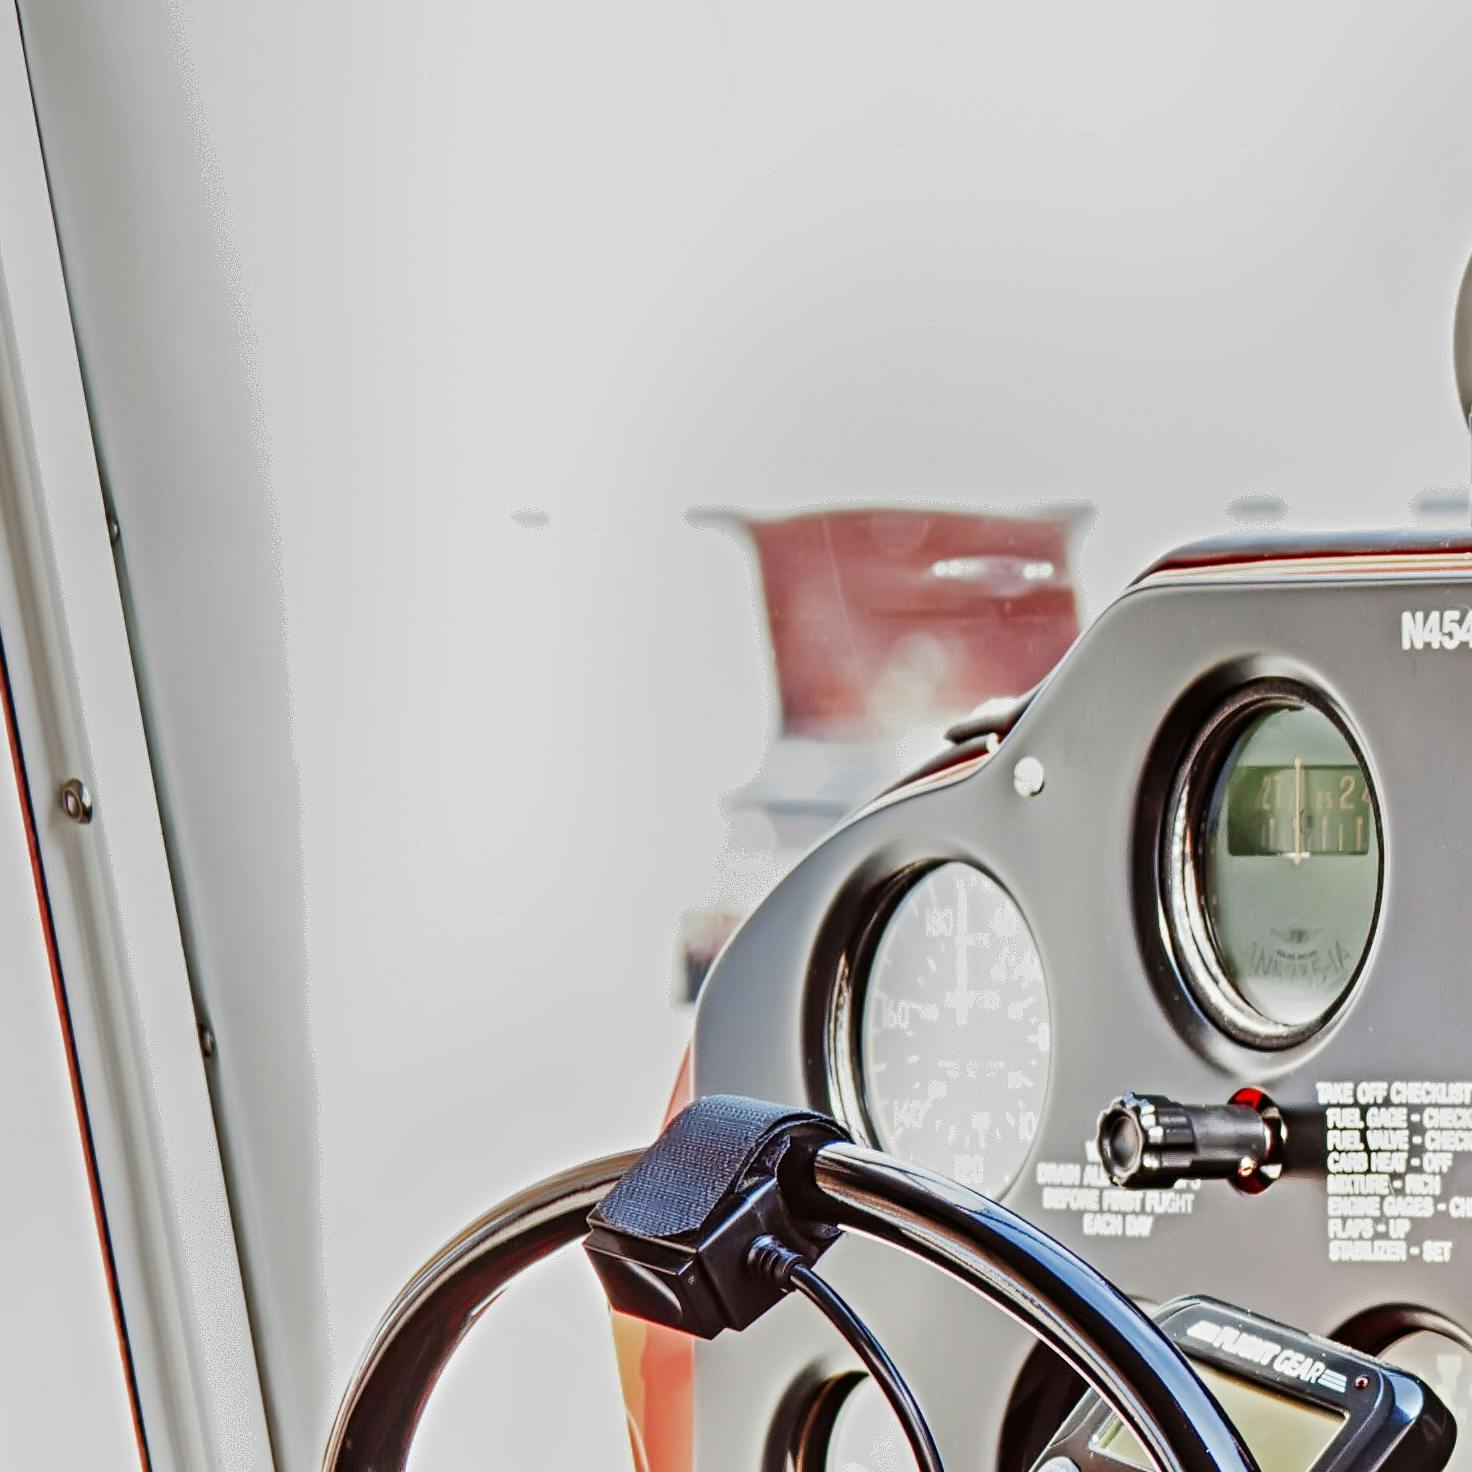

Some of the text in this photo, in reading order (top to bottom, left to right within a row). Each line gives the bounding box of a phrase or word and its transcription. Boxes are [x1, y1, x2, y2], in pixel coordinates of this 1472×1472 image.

[1356, 1081, 1389, 1105] OFF
[1326, 1107, 1365, 1128] FUEL
[1326, 1130, 1365, 1151] FUEL
[1327, 1151, 1453, 1174] CARB HEAT OFF
[1145, 1190, 1195, 1215] FLIGHT
[1083, 1212, 1154, 1237] EACH DAY
[1327, 1218, 1412, 1239] FLAPS UP
[1422, 1240, 1453, 1262] SET
[1273, 1349, 1326, 1385] GEAR
